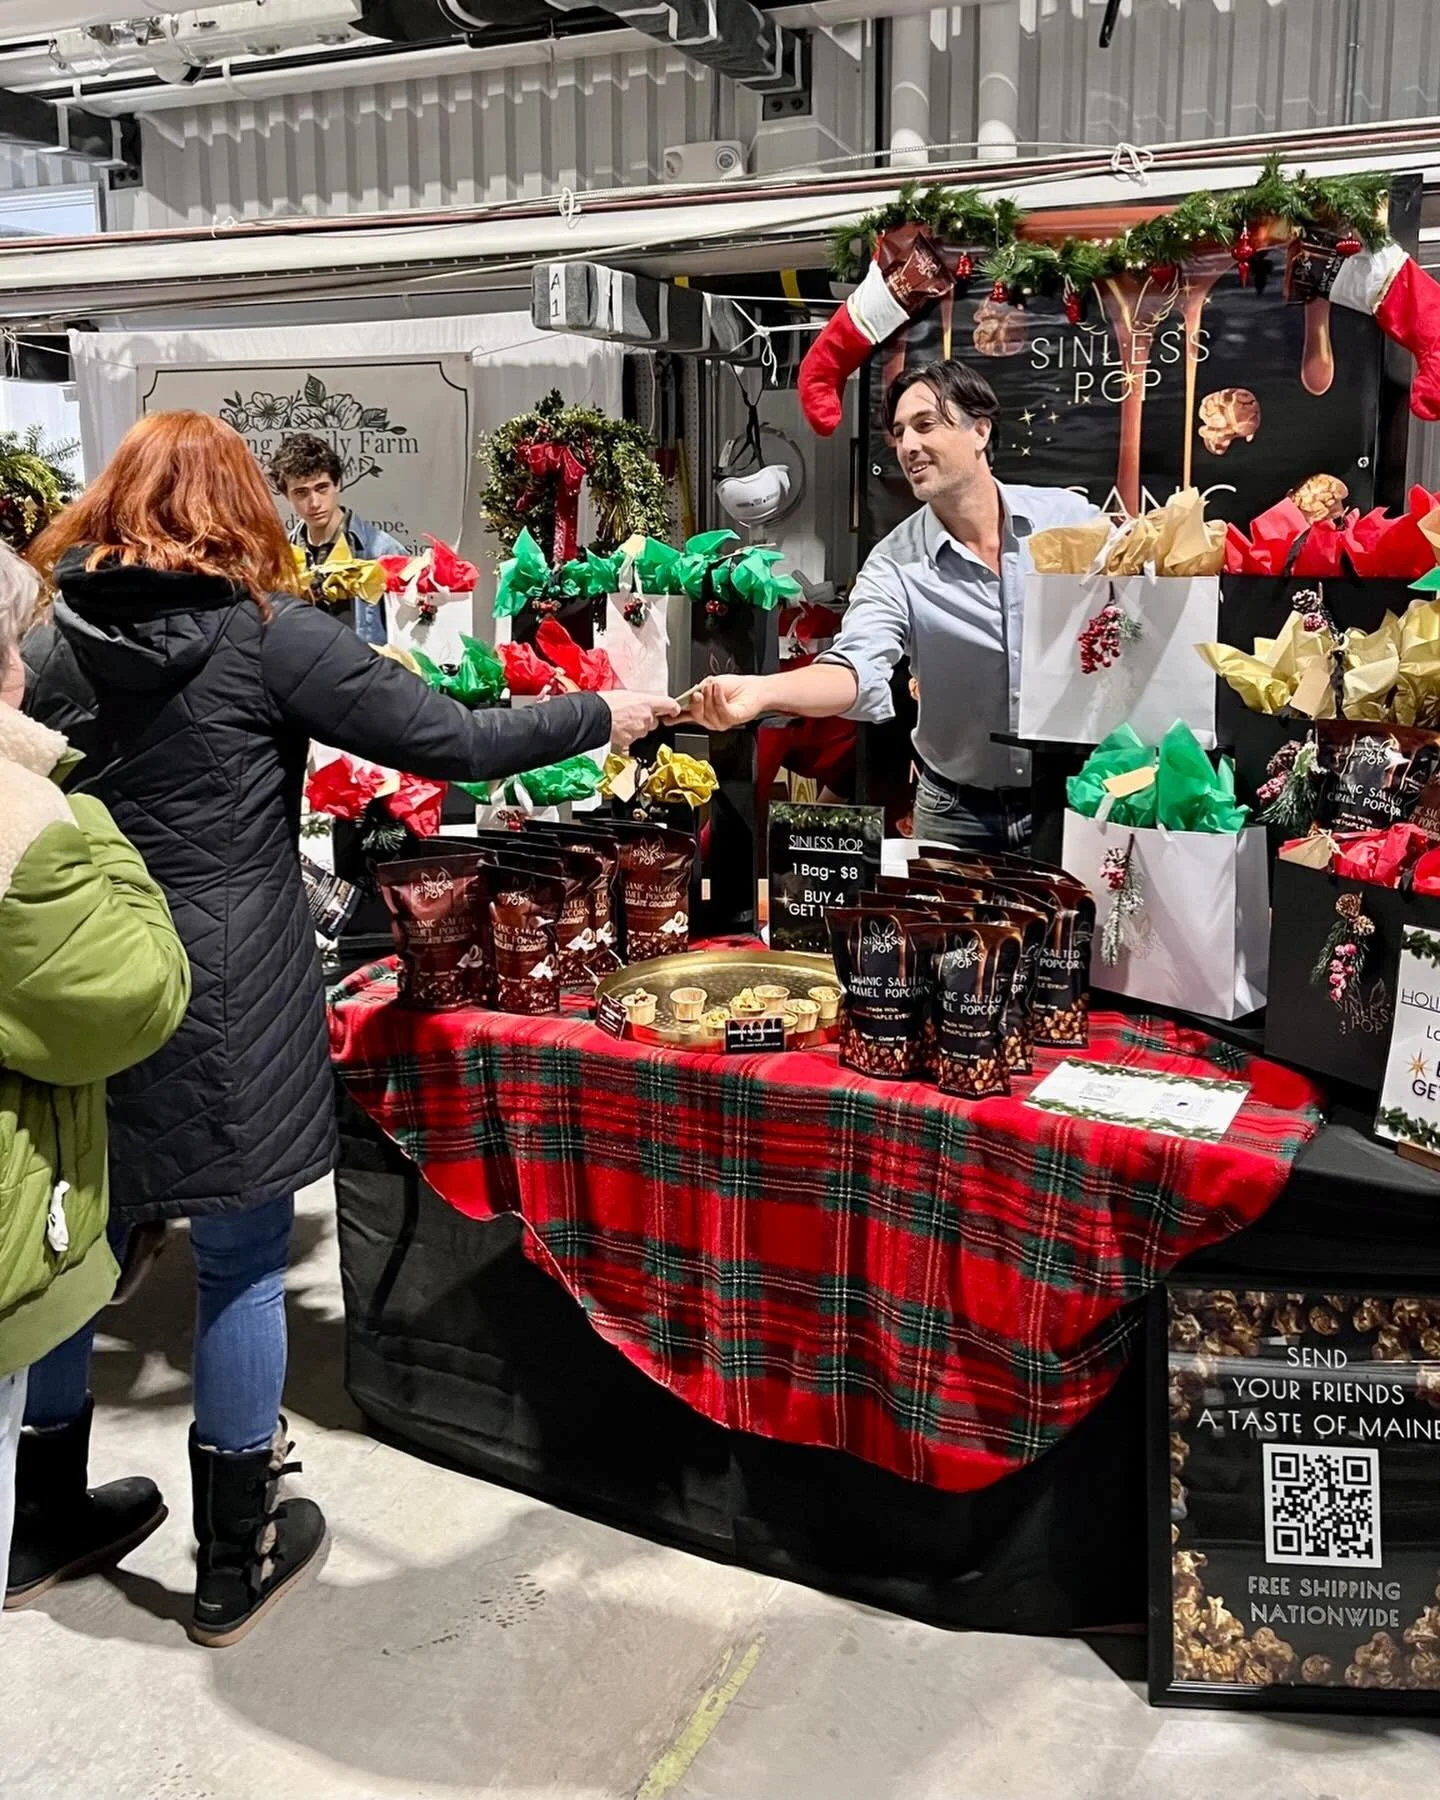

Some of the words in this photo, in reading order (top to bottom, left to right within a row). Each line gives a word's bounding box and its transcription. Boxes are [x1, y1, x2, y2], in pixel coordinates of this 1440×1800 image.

[550, 273, 560, 290] A
[551, 299, 561, 317] 1
[1031, 330, 1211, 369] SINLESS
[1074, 369, 1162, 403] POP
[359, 431, 419, 453] Farm
[1360, 755, 1385, 766] POP
[1362, 797, 1401, 817] POPCOR
[788, 834, 834, 851] SINLESS
[838, 837, 864, 852] POP
[639, 856, 657, 866] POP
[792, 862, 798, 875] 1
[840, 865, 859, 880] $8
[804, 889, 832, 904] BUY
[834, 892, 845, 905] 4
[788, 902, 816, 917] GET
[819, 904, 825, 918] 1
[862, 935, 905, 947] SINLESS
[871, 943, 893, 954] POP
[945, 949, 985, 963] SINLESS
[1042, 947, 1080, 960] SALTED
[950, 957, 973, 969] POP
[1401, 988, 1440, 1010] HOLI
[960, 1004, 1000, 1016] POPCOR
[1411, 1079, 1440, 1102] GE
[1286, 1346, 1347, 1369] SEND
[1232, 1377, 1301, 1400] YOUR
[1312, 1381, 1405, 1405] FRIENDS
[1196, 1408, 1218, 1429] A
[1228, 1410, 1302, 1434] TASTE
[1313, 1414, 1347, 1436] OF
[1248, 1575, 1291, 1596] FREE
[1299, 1578, 1401, 1601] SHIPPING
[1250, 1601, 1400, 1628] NATIONWIDE
